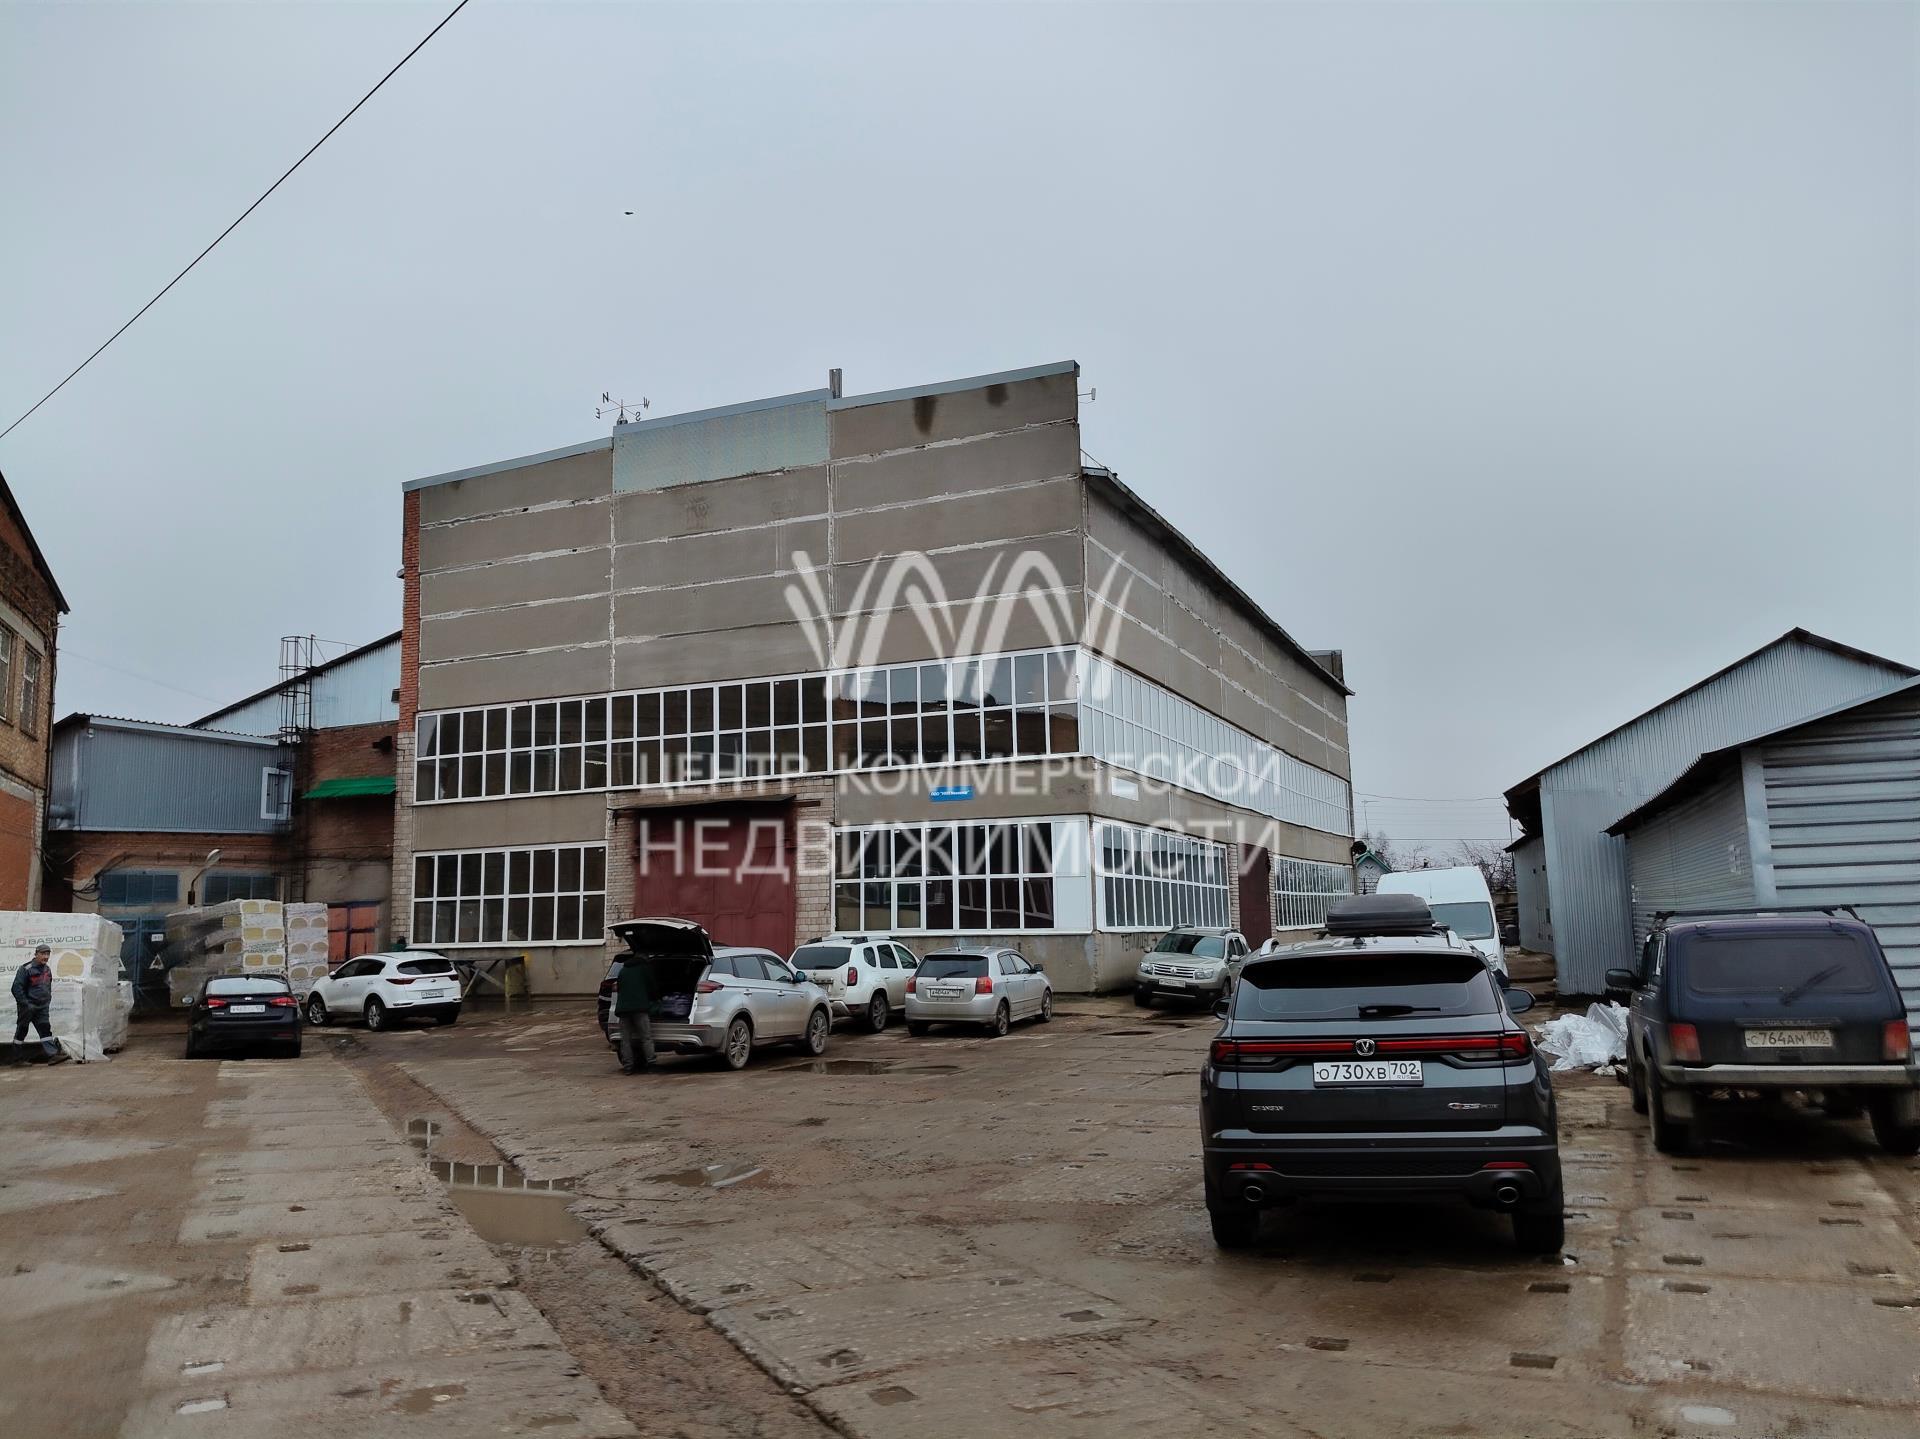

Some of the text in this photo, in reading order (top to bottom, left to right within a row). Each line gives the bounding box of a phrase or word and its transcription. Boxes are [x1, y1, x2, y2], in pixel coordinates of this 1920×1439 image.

[602, 391, 609, 403] N
[28, 935, 89, 945] BASWOOL
[1319, 1064, 1387, 1080] О730ХВ
[1390, 1062, 1417, 1075] 702
